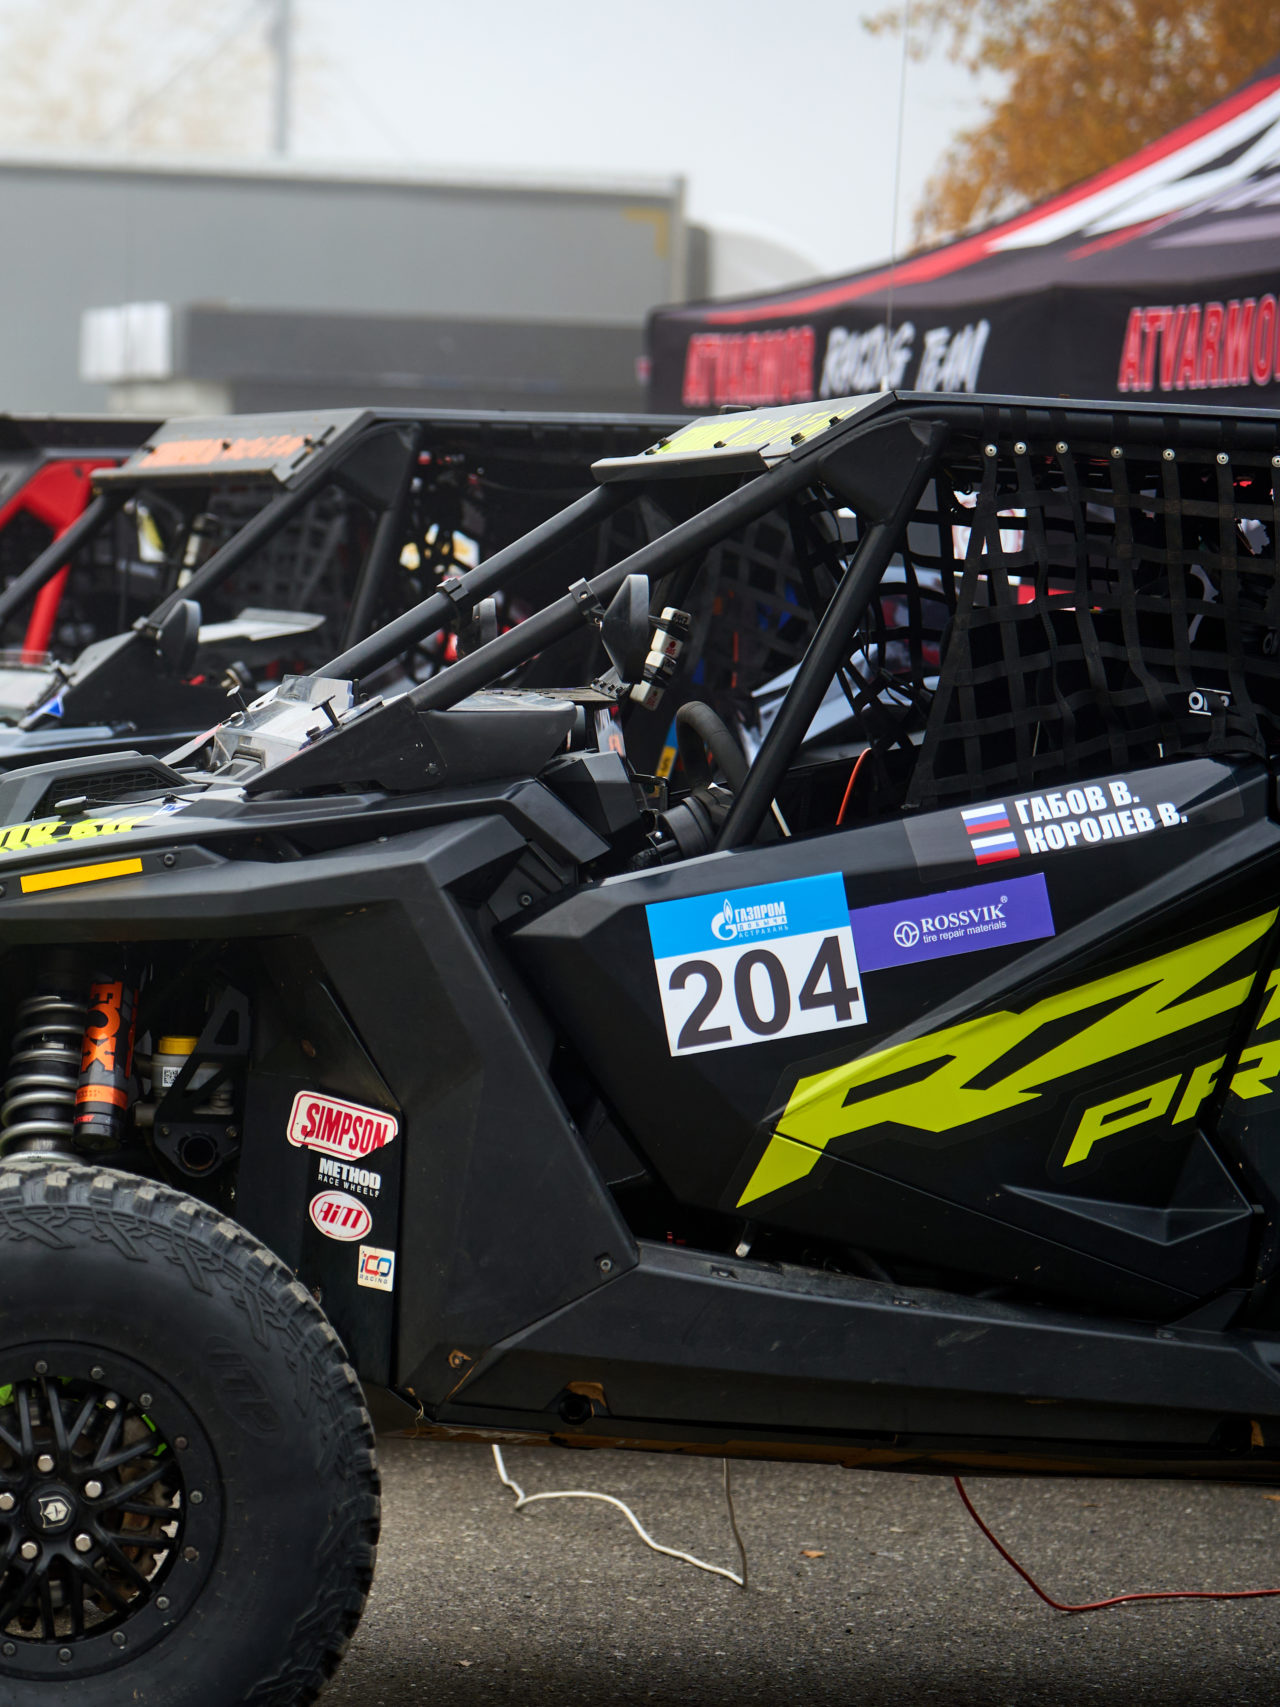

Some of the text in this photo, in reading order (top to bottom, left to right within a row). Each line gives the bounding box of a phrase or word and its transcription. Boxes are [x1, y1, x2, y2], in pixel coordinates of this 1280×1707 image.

[915, 318, 990, 393] TEAM
[1117, 293, 1280, 393] ATVARMO
[1014, 781, 1140, 825] ГАБОВ В.
[1024, 802, 1188, 855] КОРОЛЕВ В.
[734, 900, 786, 923] ГАЗПРОМ
[738, 925, 789, 938] АСТРАХАНЬ
[921, 903, 1006, 933] ROSSVIK
[923, 921, 1007, 944] tire repair materials
[668, 935, 860, 1050] 204
[81, 981, 123, 1073] FOX
[736, 906, 1280, 1209] RZ
[300, 1102, 389, 1154] SIMPSON
[318, 1174, 380, 1198] RACE WHEELS
[319, 1157, 381, 1190] METHOD
[359, 1273, 389, 1285] RACING
